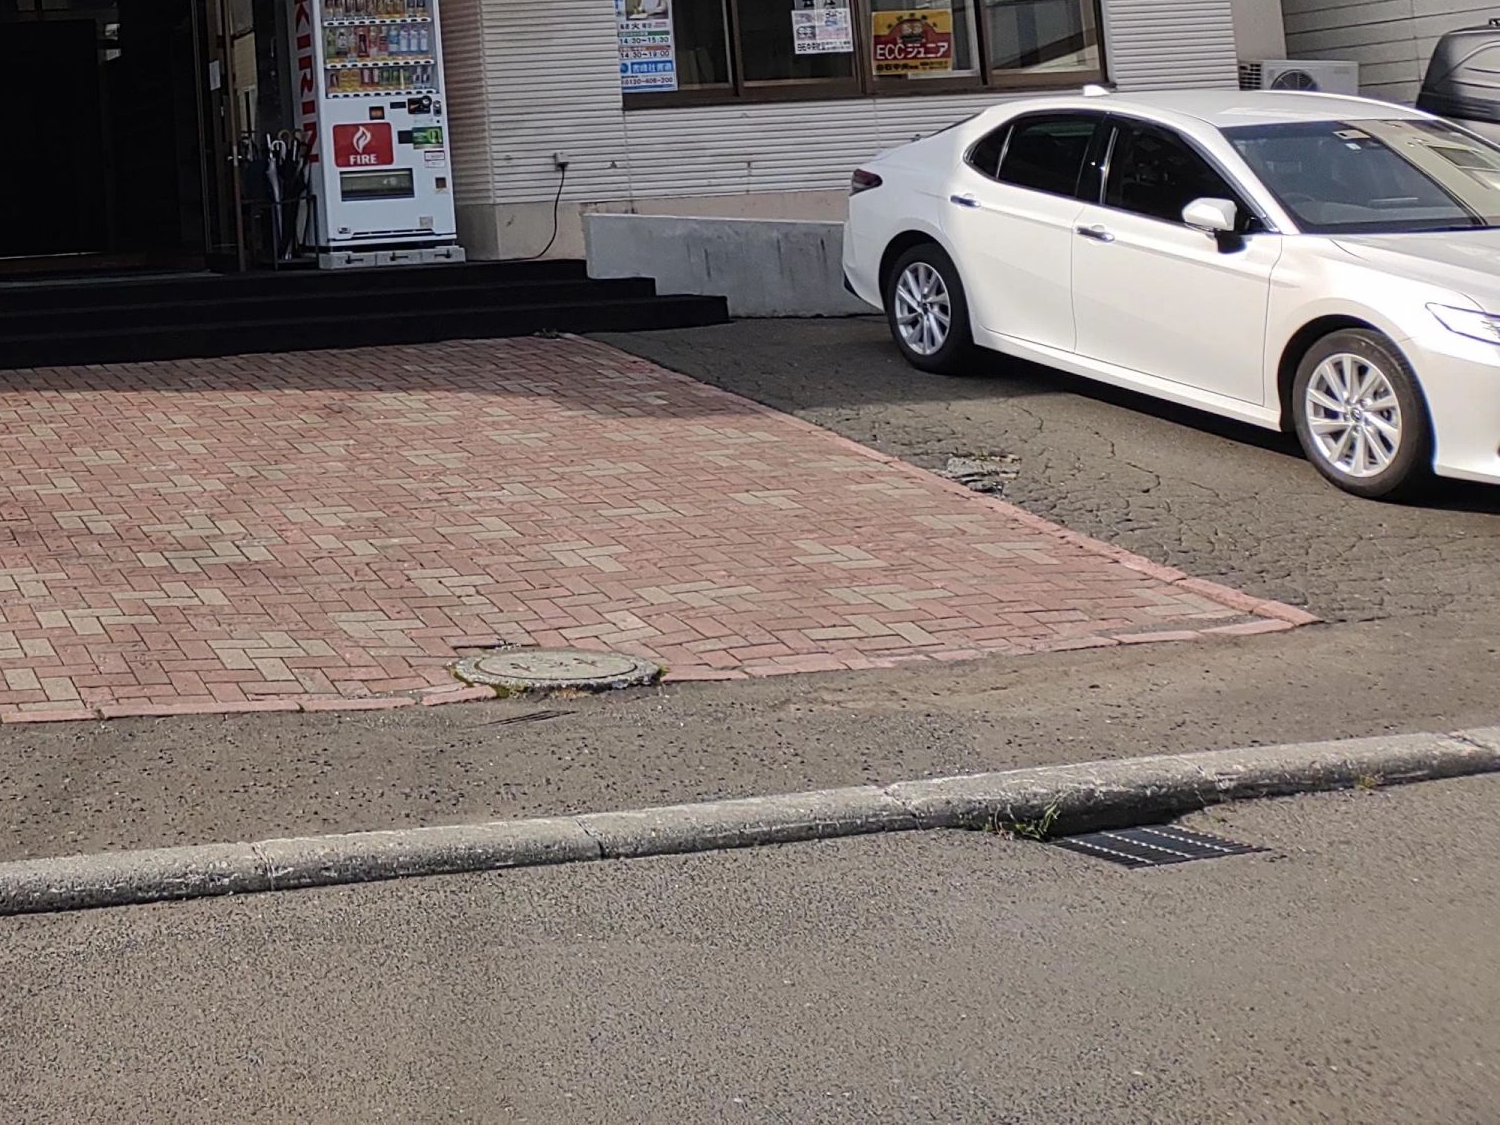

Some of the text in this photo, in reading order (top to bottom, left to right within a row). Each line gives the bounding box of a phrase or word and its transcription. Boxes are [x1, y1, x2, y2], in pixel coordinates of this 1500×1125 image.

[876, 43, 948, 59] ECCジュニア
[349, 154, 378, 165] FIRE
